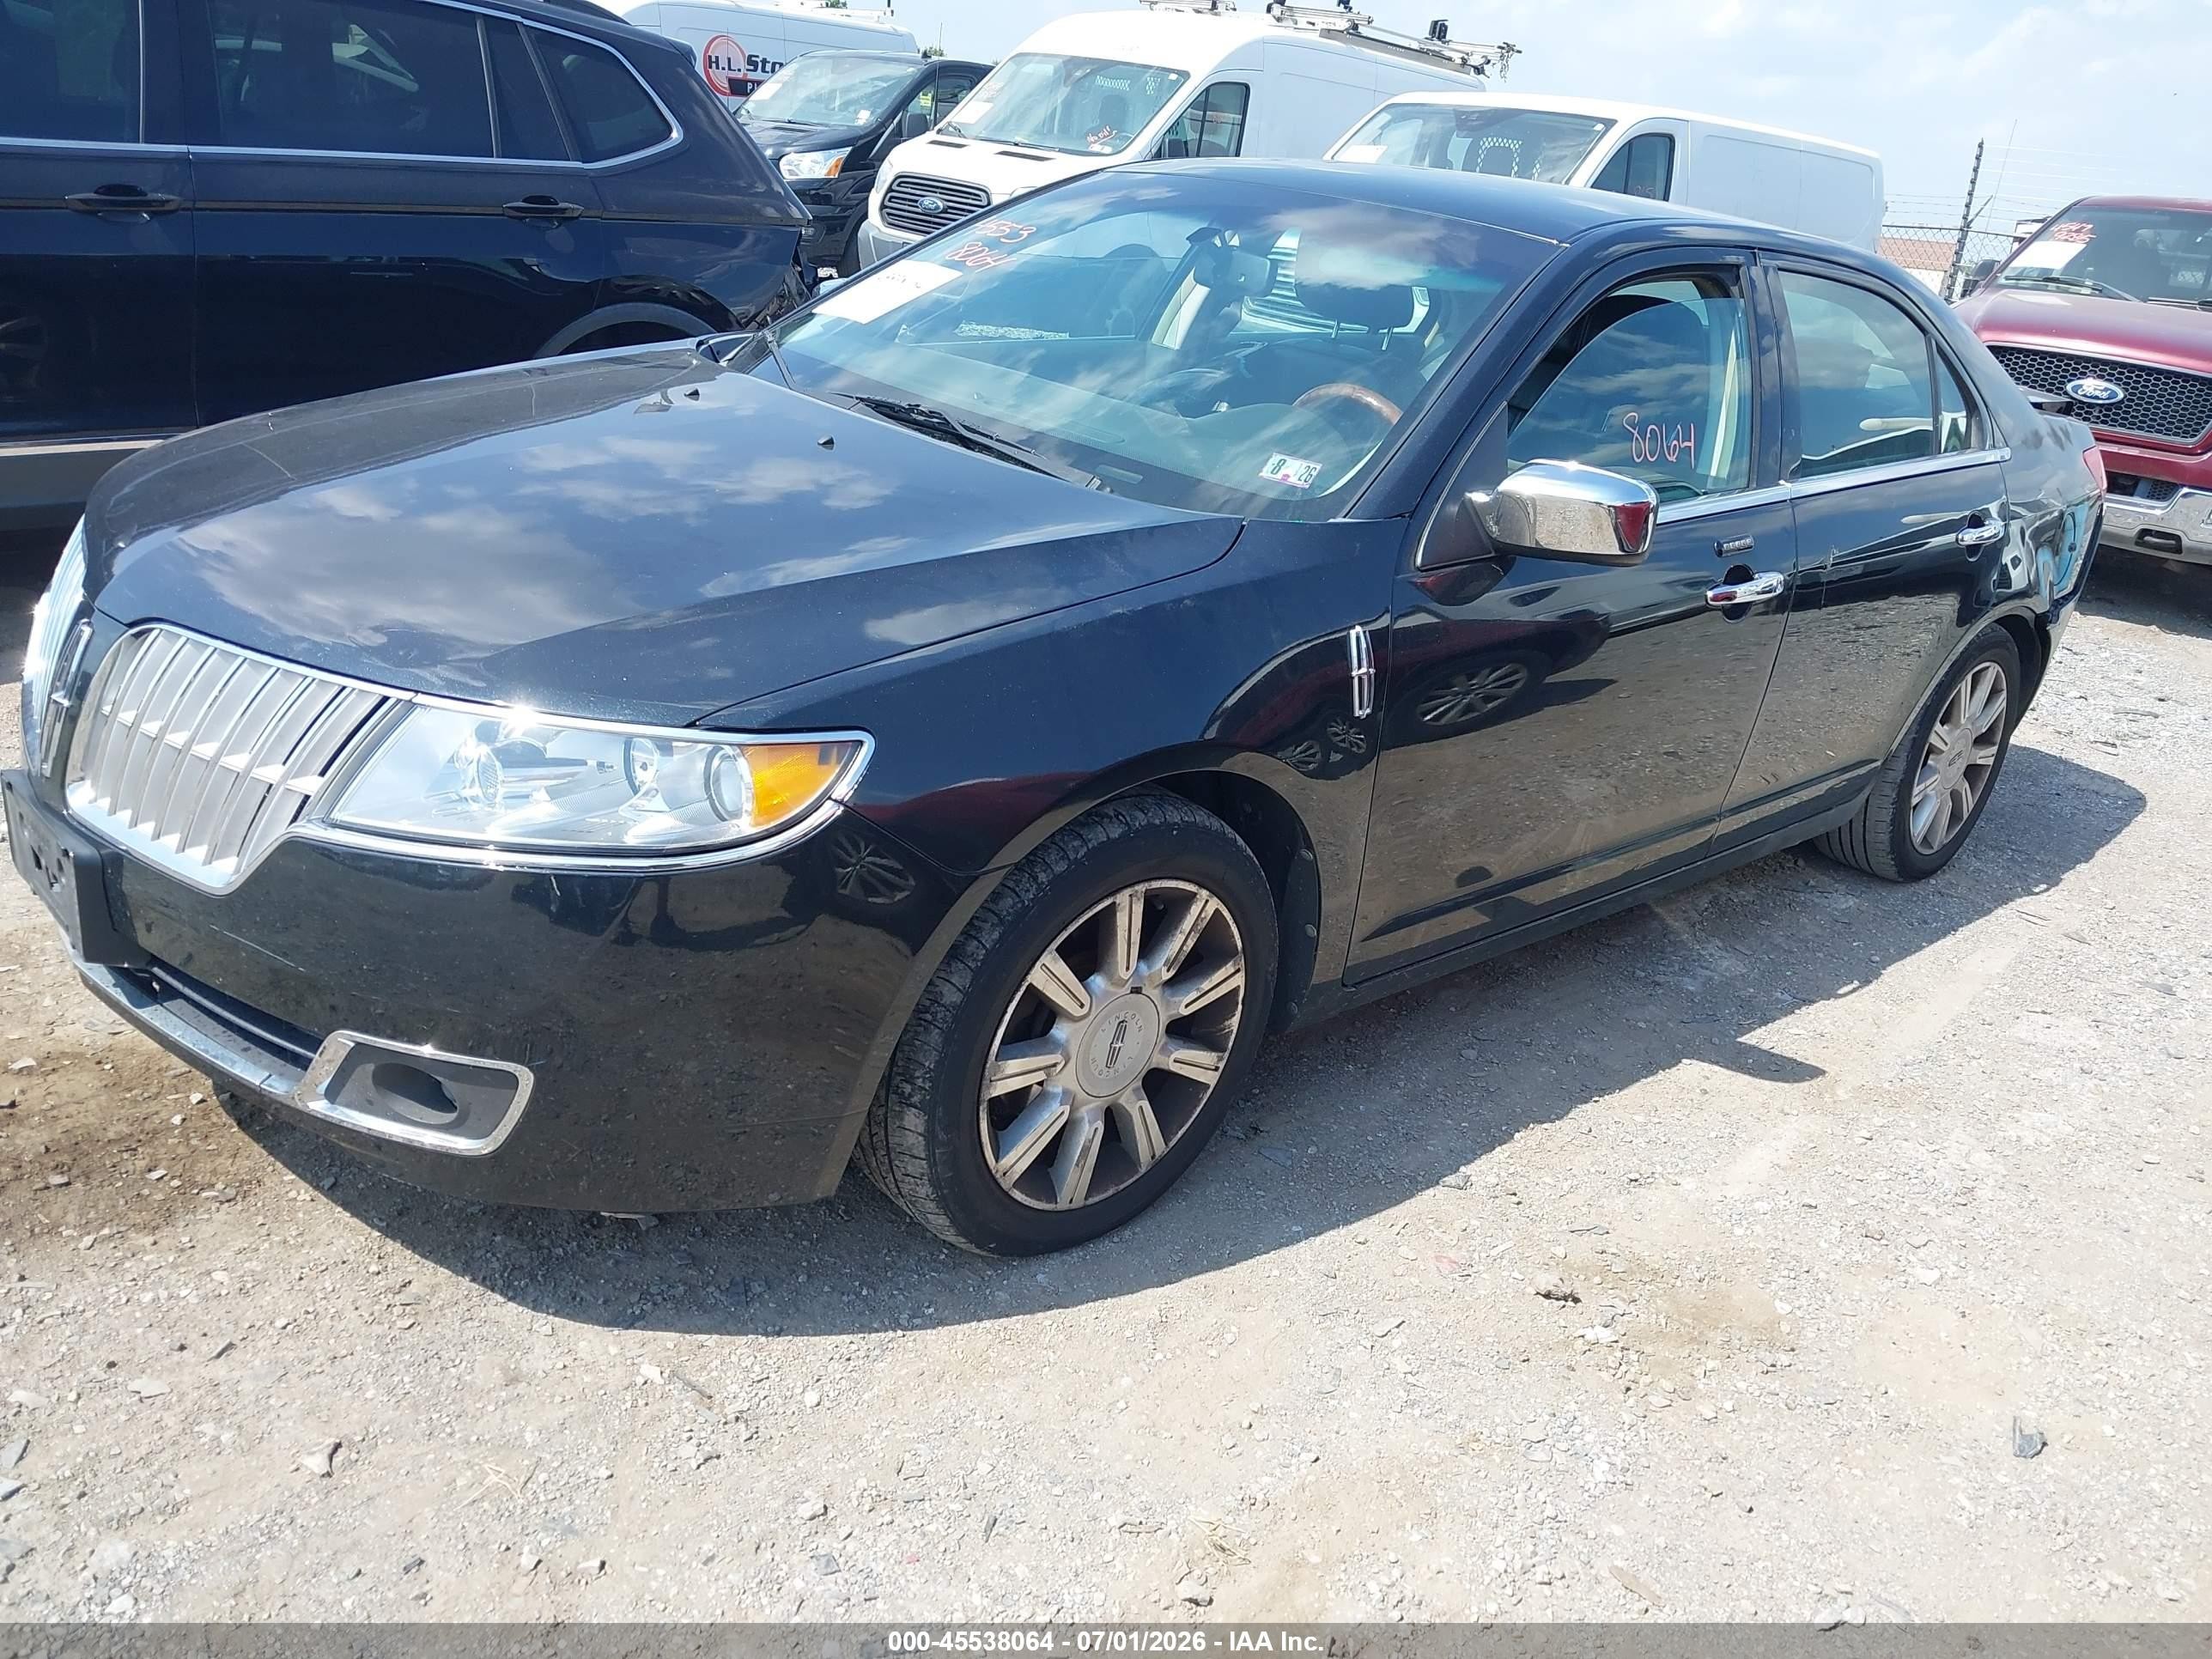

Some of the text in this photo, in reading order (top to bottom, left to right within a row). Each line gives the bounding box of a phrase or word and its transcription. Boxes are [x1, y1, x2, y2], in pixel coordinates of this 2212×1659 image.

[945, 241, 1018, 273] 8064
[1622, 412, 1695, 469] 8064
[1298, 465, 1317, 483] 26
[1101, 1012, 1144, 1033] LINCOLN
